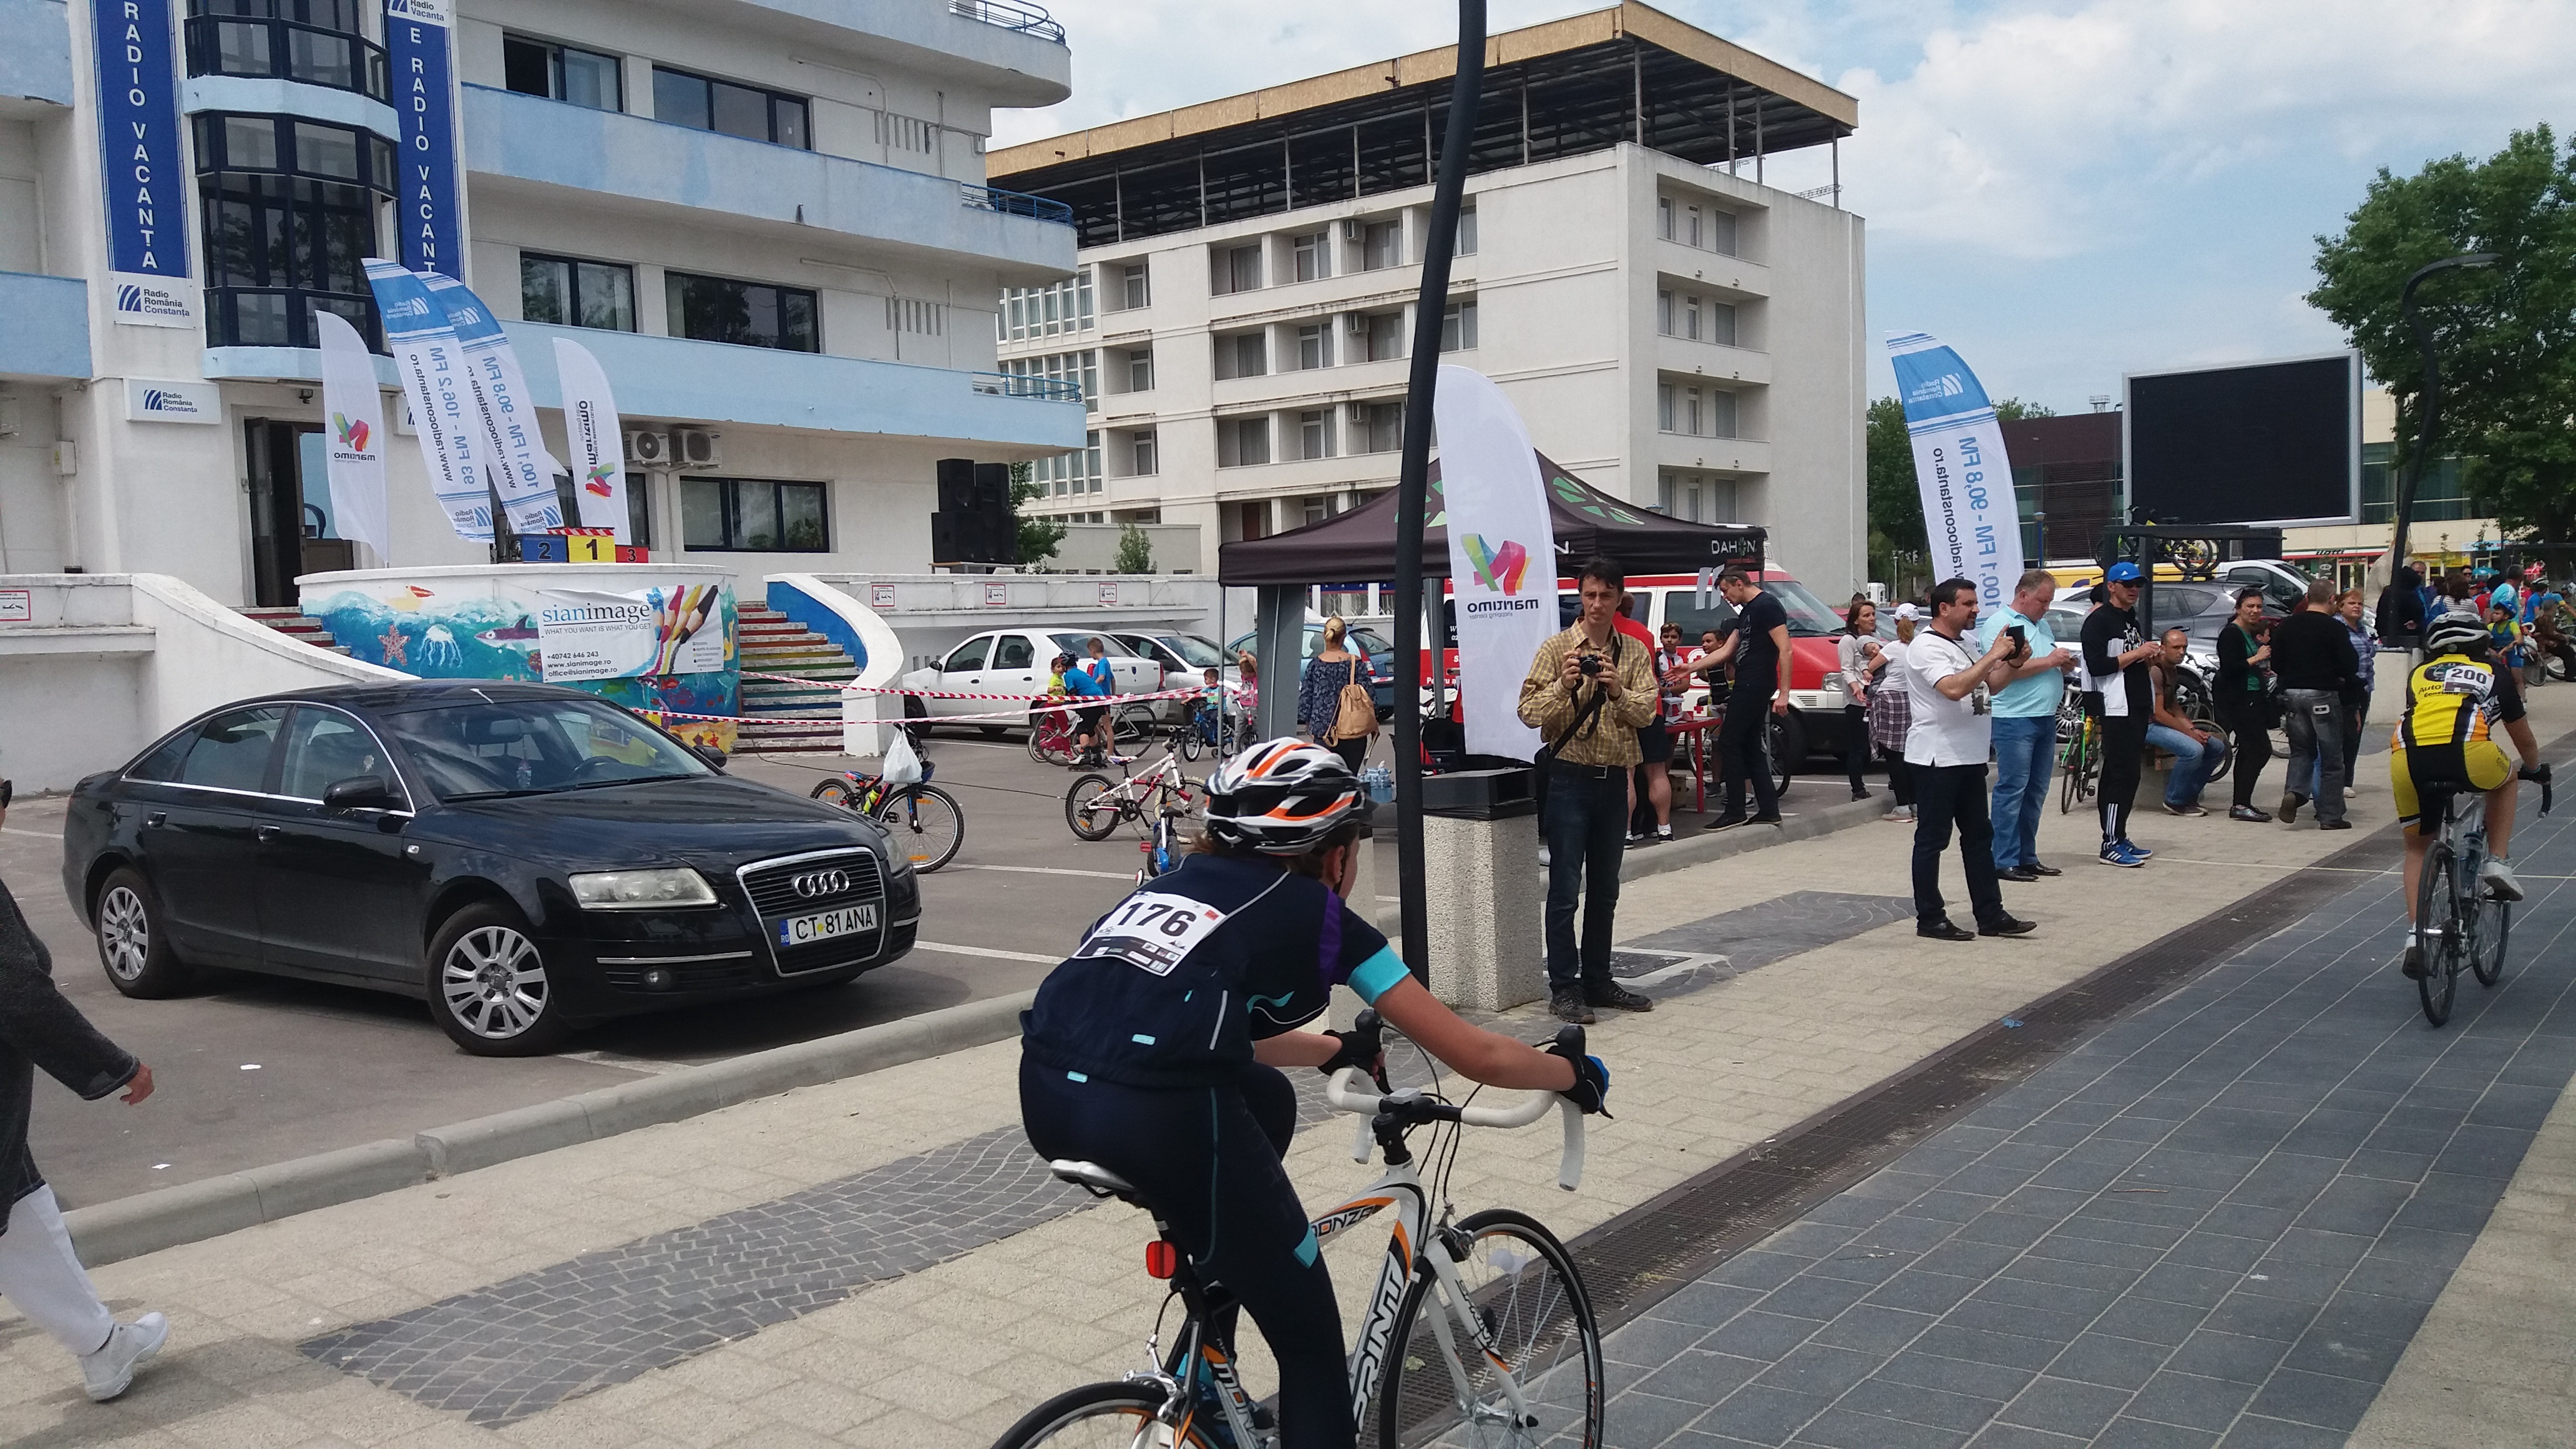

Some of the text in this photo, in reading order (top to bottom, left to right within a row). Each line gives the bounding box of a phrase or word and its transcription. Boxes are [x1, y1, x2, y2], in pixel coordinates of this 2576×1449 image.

[410, 27, 422, 44] E
[124, 1, 146, 107] RADIO
[411, 57, 430, 151] RADIO
[144, 289, 169, 298] Radio
[144, 297, 183, 308] România
[538, 542, 552, 560] 2
[587, 539, 598, 560] 1
[627, 549, 637, 562] 3
[542, 603, 650, 624] sianimage
[547, 660, 612, 668] www.sianimage.ro
[548, 668, 618, 677] office@sianimage.ro
[2451, 668, 2487, 685] 200
[796, 906, 874, 940] CT 81 ANA
[1117, 902, 1198, 937] 176
[781, 934, 790, 944] RO
